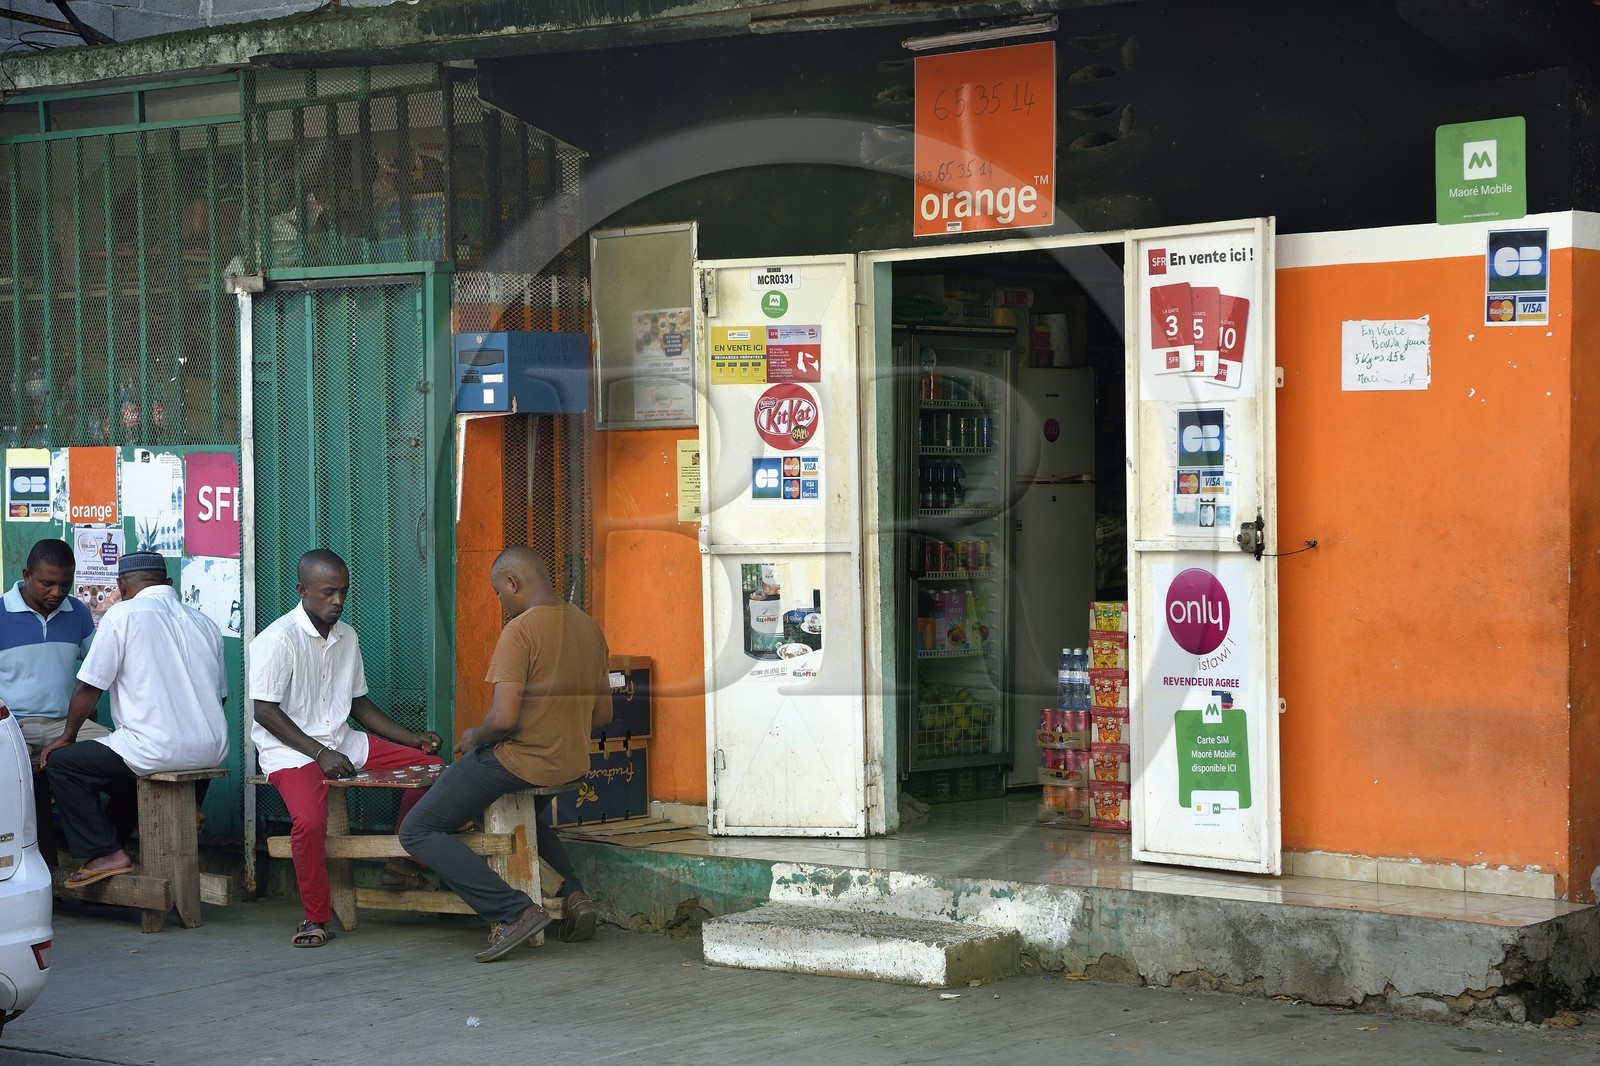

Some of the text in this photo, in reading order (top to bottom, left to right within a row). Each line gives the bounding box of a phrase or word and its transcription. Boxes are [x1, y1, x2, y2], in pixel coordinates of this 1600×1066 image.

[933, 81, 1035, 120] 65 35 14
[957, 159, 976, 179] 35
[1449, 183, 1513, 198] Maoré Mobile
[920, 185, 1038, 224] orange
[1151, 257, 1167, 267] SFR
[1170, 252, 1186, 266] En
[1189, 250, 1226, 265] vente
[1230, 248, 1246, 262] ici
[757, 274, 793, 285] MCR0331
[1522, 303, 1542, 313] VISA
[1165, 315, 1178, 337] 3
[1193, 318, 1204, 340] 5
[1219, 326, 1237, 349] 10
[803, 462, 816, 471] VISA
[1205, 478, 1221, 487] VISA
[72, 505, 112, 521] orange
[1169, 594, 1223, 631] only
[1163, 676, 1240, 688] REVENDEUR AGREE
[1196, 736, 1230, 744] Carte SIM
[1191, 749, 1236, 758] Maoré Mobile
[1191, 764, 1237, 774] disponible ICI
